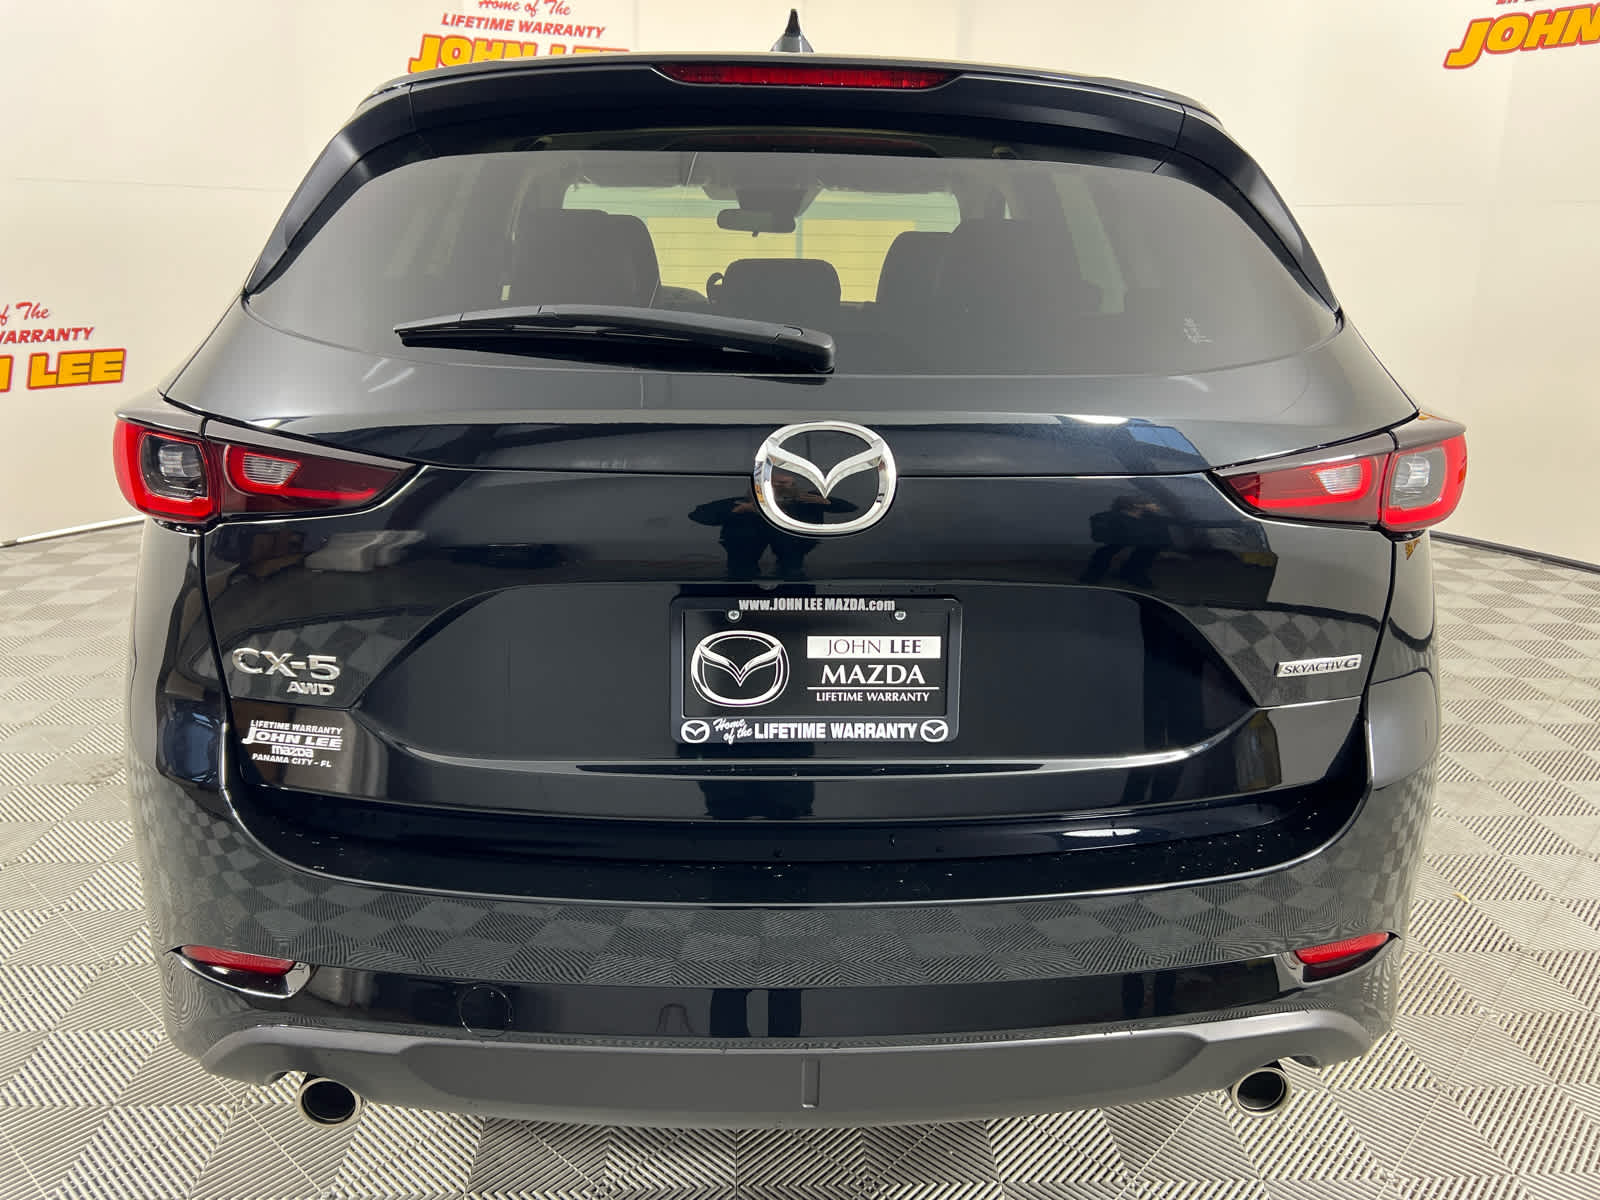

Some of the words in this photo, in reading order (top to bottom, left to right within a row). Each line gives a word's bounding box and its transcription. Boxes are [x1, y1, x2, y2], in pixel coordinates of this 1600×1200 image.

[524, 0, 539, 17] of
[543, 0, 571, 15] The
[441, 12, 514, 32] LIFETIME
[518, 20, 606, 39] WARRANTY
[1442, 2, 1600, 69] JOHN
[0, 304, 9, 326] f
[16, 301, 49, 320] The
[27, 348, 127, 390] LEE
[804, 598, 823, 611] LEE
[824, 598, 896, 611] MAZDA.com
[826, 639, 882, 656] JOHN
[890, 639, 922, 654] LEE
[231, 647, 341, 680] CX-5
[821, 664, 926, 684] MAZDA
[286, 681, 335, 696] AWD
[816, 692, 863, 702] LIFETIME
[866, 692, 930, 702] WARRANTY
[250, 719, 290, 731] LIFETIME
[292, 723, 343, 735] WARRANTY
[712, 717, 745, 731] Home
[754, 722, 827, 739] LIFETIME
[831, 722, 918, 739] WARRANTY
[241, 726, 301, 745] JOHN
[304, 736, 344, 749] LEE
[723, 727, 735, 745] of
[736, 723, 753, 739] the
[251, 753, 289, 764] PANAMA
[291, 757, 313, 766] CITY
[320, 760, 332, 768] FL
